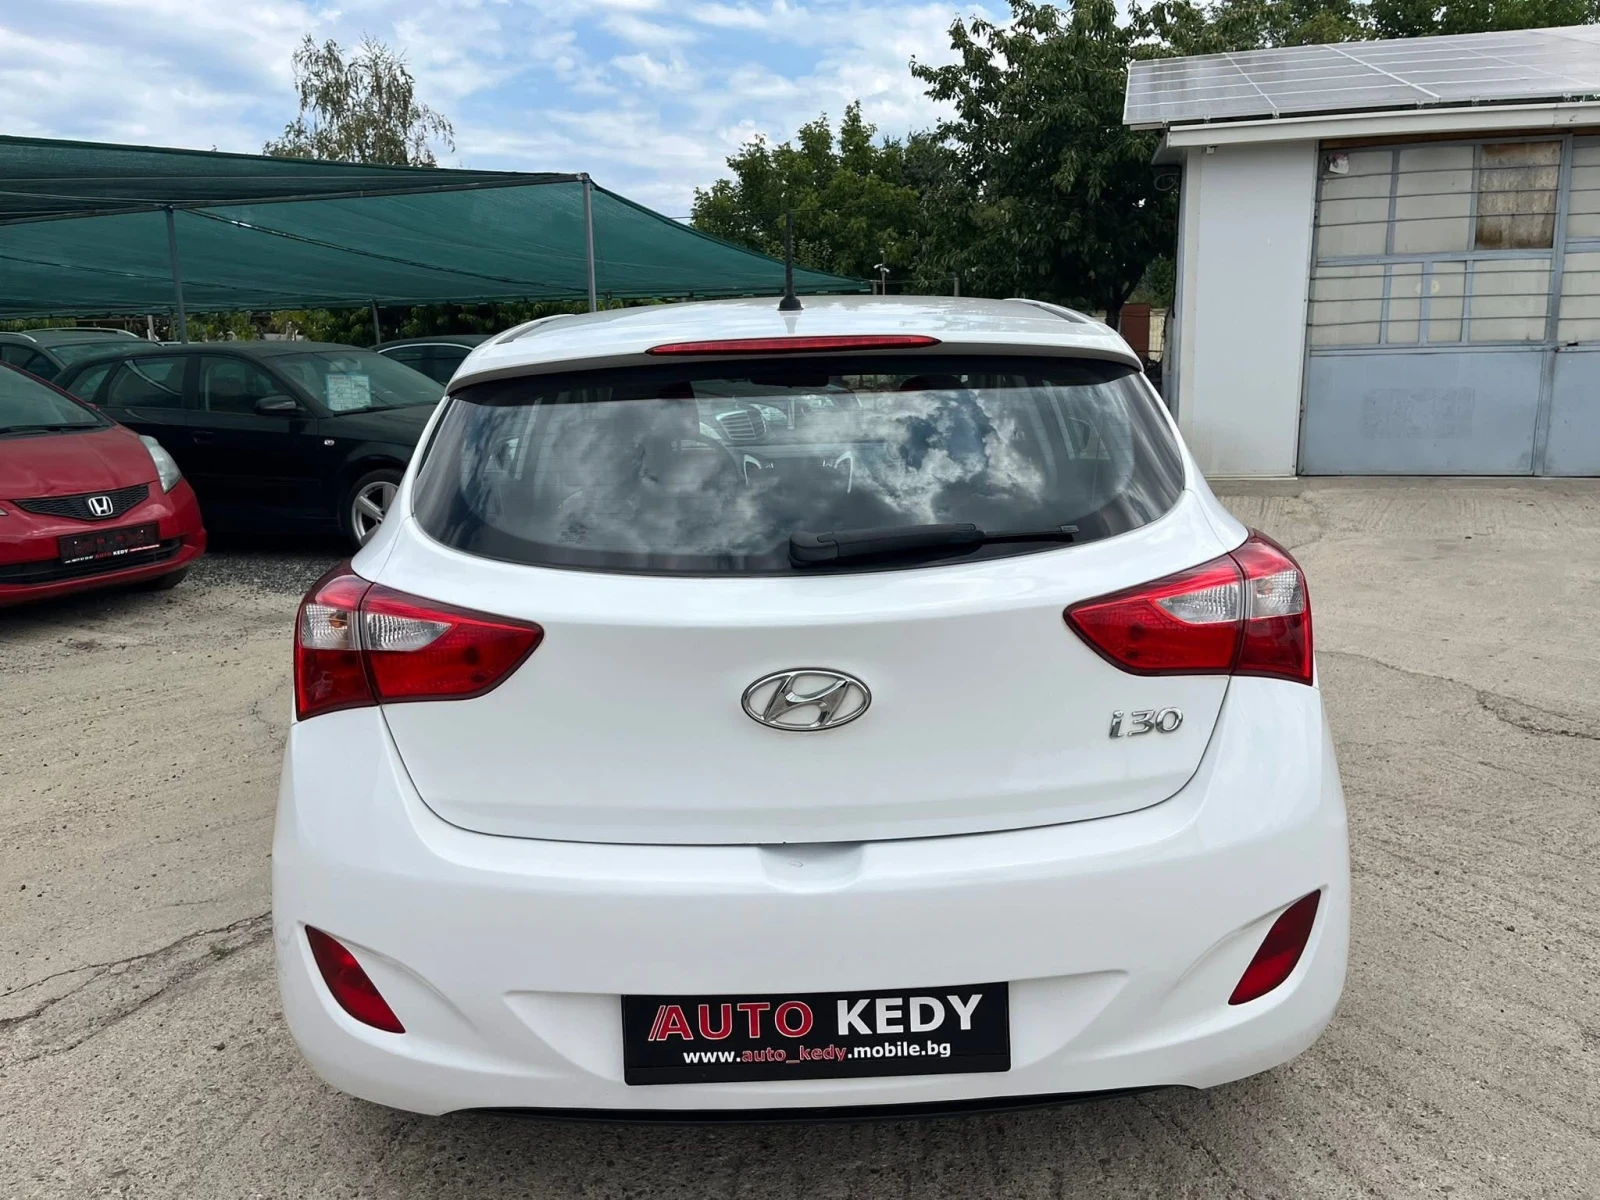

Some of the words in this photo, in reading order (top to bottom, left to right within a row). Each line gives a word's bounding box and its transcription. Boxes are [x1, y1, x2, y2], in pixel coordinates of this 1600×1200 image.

[1109, 707, 1184, 739] i30
[648, 1000, 814, 1041] AUTO
[837, 994, 983, 1036] KEDY
[683, 1040, 951, 1064] www.auto_kedy.mobile.bg
